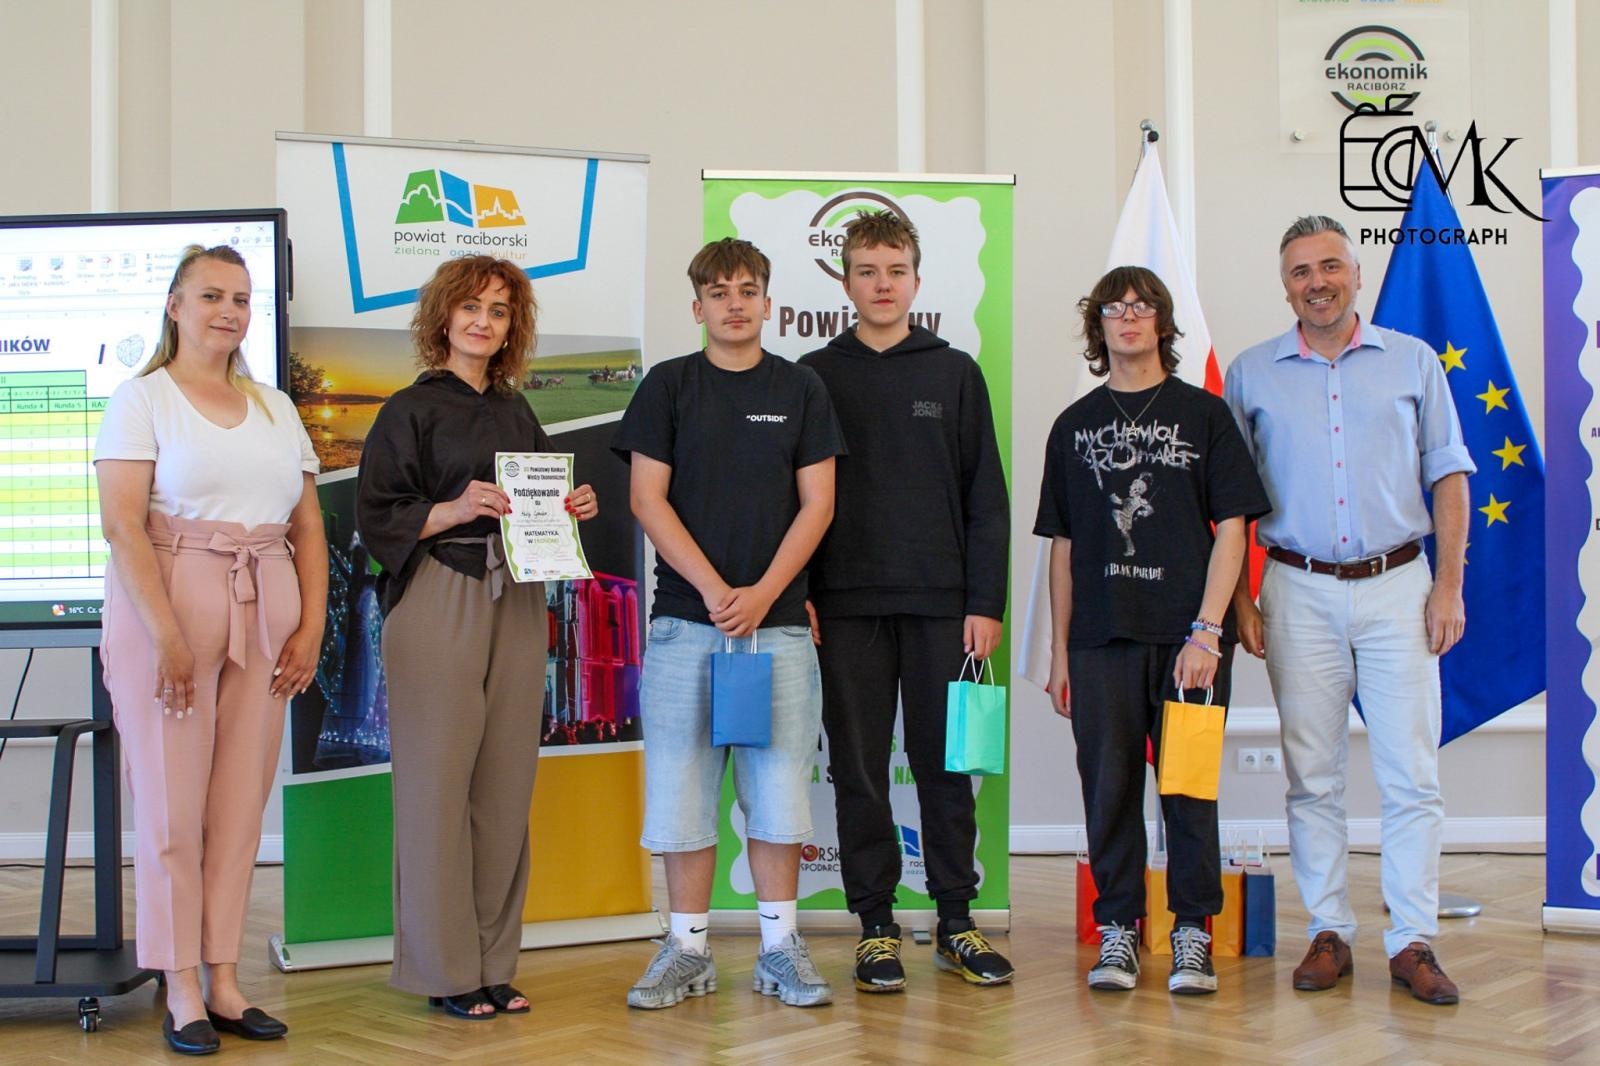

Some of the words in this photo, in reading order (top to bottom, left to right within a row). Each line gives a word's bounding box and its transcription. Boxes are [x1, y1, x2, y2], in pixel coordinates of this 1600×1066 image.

[1325, 63, 1428, 80] ekonomik
[1347, 80, 1406, 91] RACIBÓRZ
[394, 229, 447, 245] powiat
[456, 232, 528, 248] raciborski
[394, 246, 440, 256] zielona
[513, 488, 560, 499] Podziękowanie
